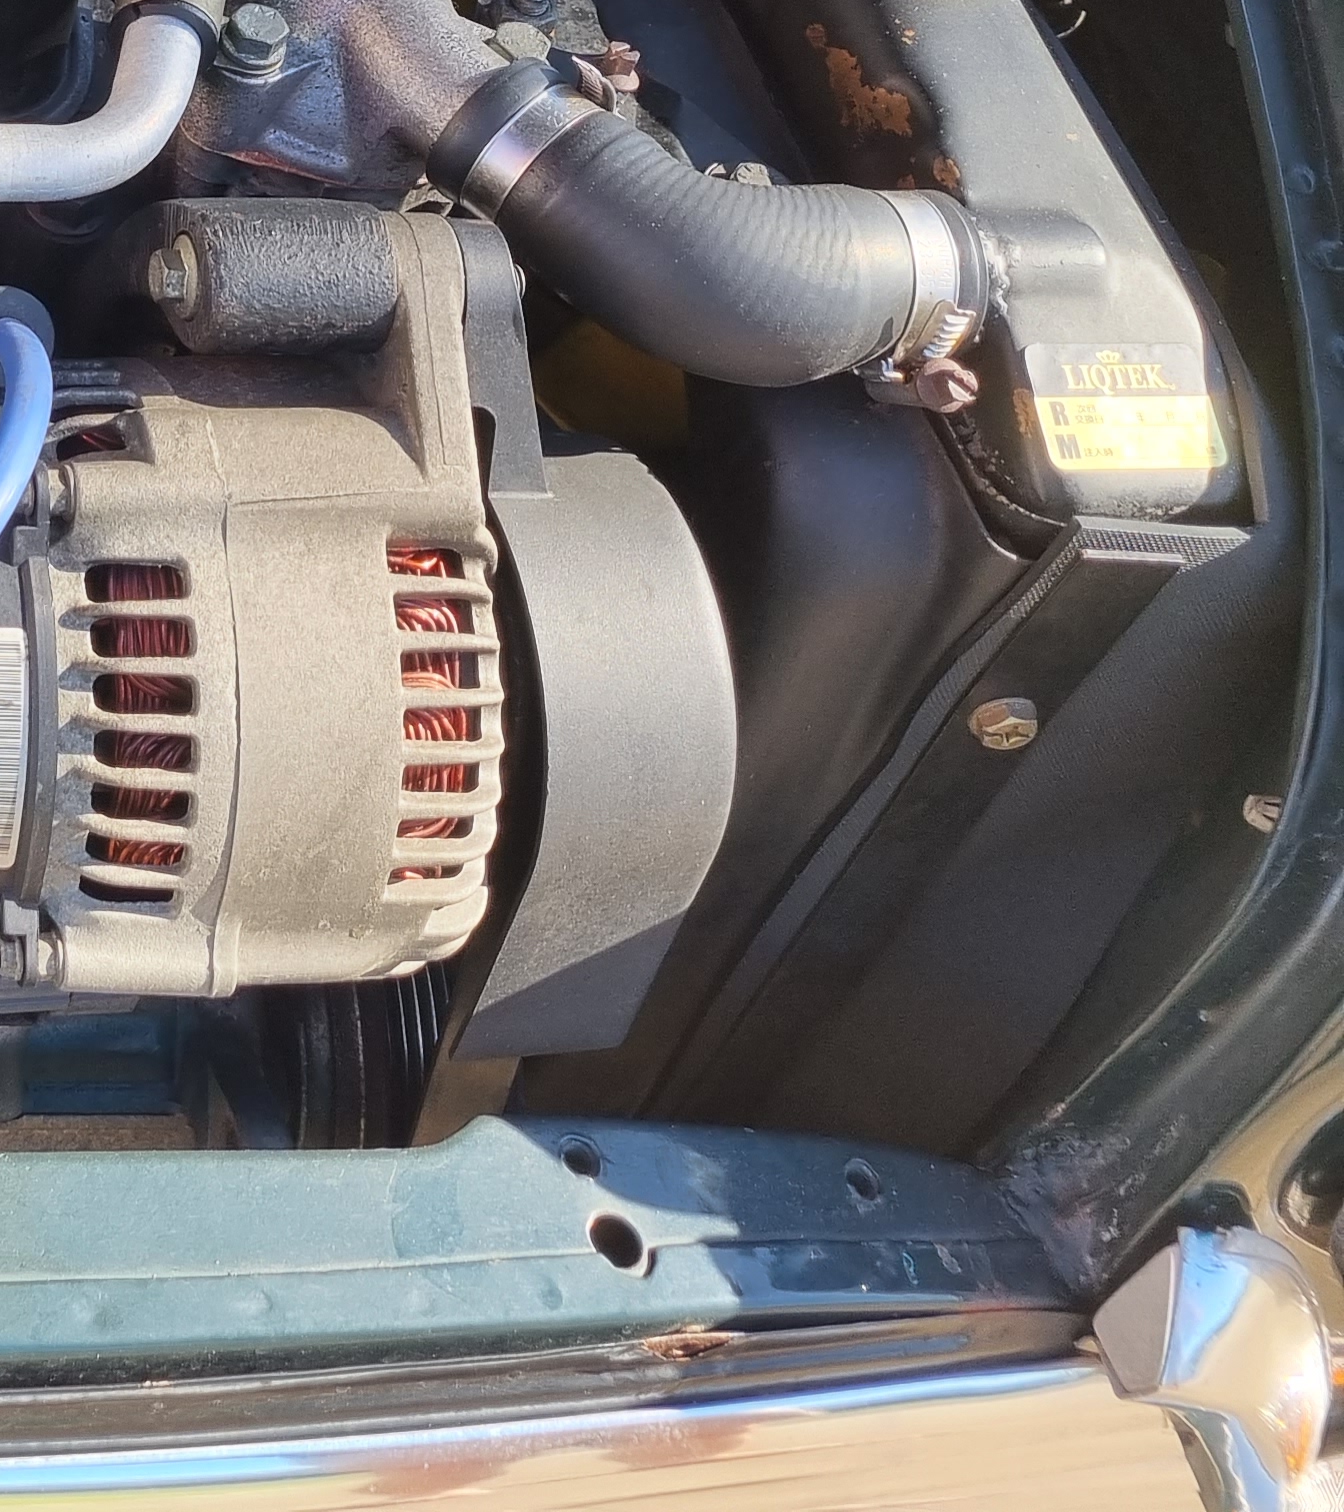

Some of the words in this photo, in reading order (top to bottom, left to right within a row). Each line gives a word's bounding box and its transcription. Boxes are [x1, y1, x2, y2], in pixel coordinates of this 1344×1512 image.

[1061, 363, 1172, 395] LIQTEK
[1048, 401, 1070, 426] R
[1055, 434, 1081, 460] M
